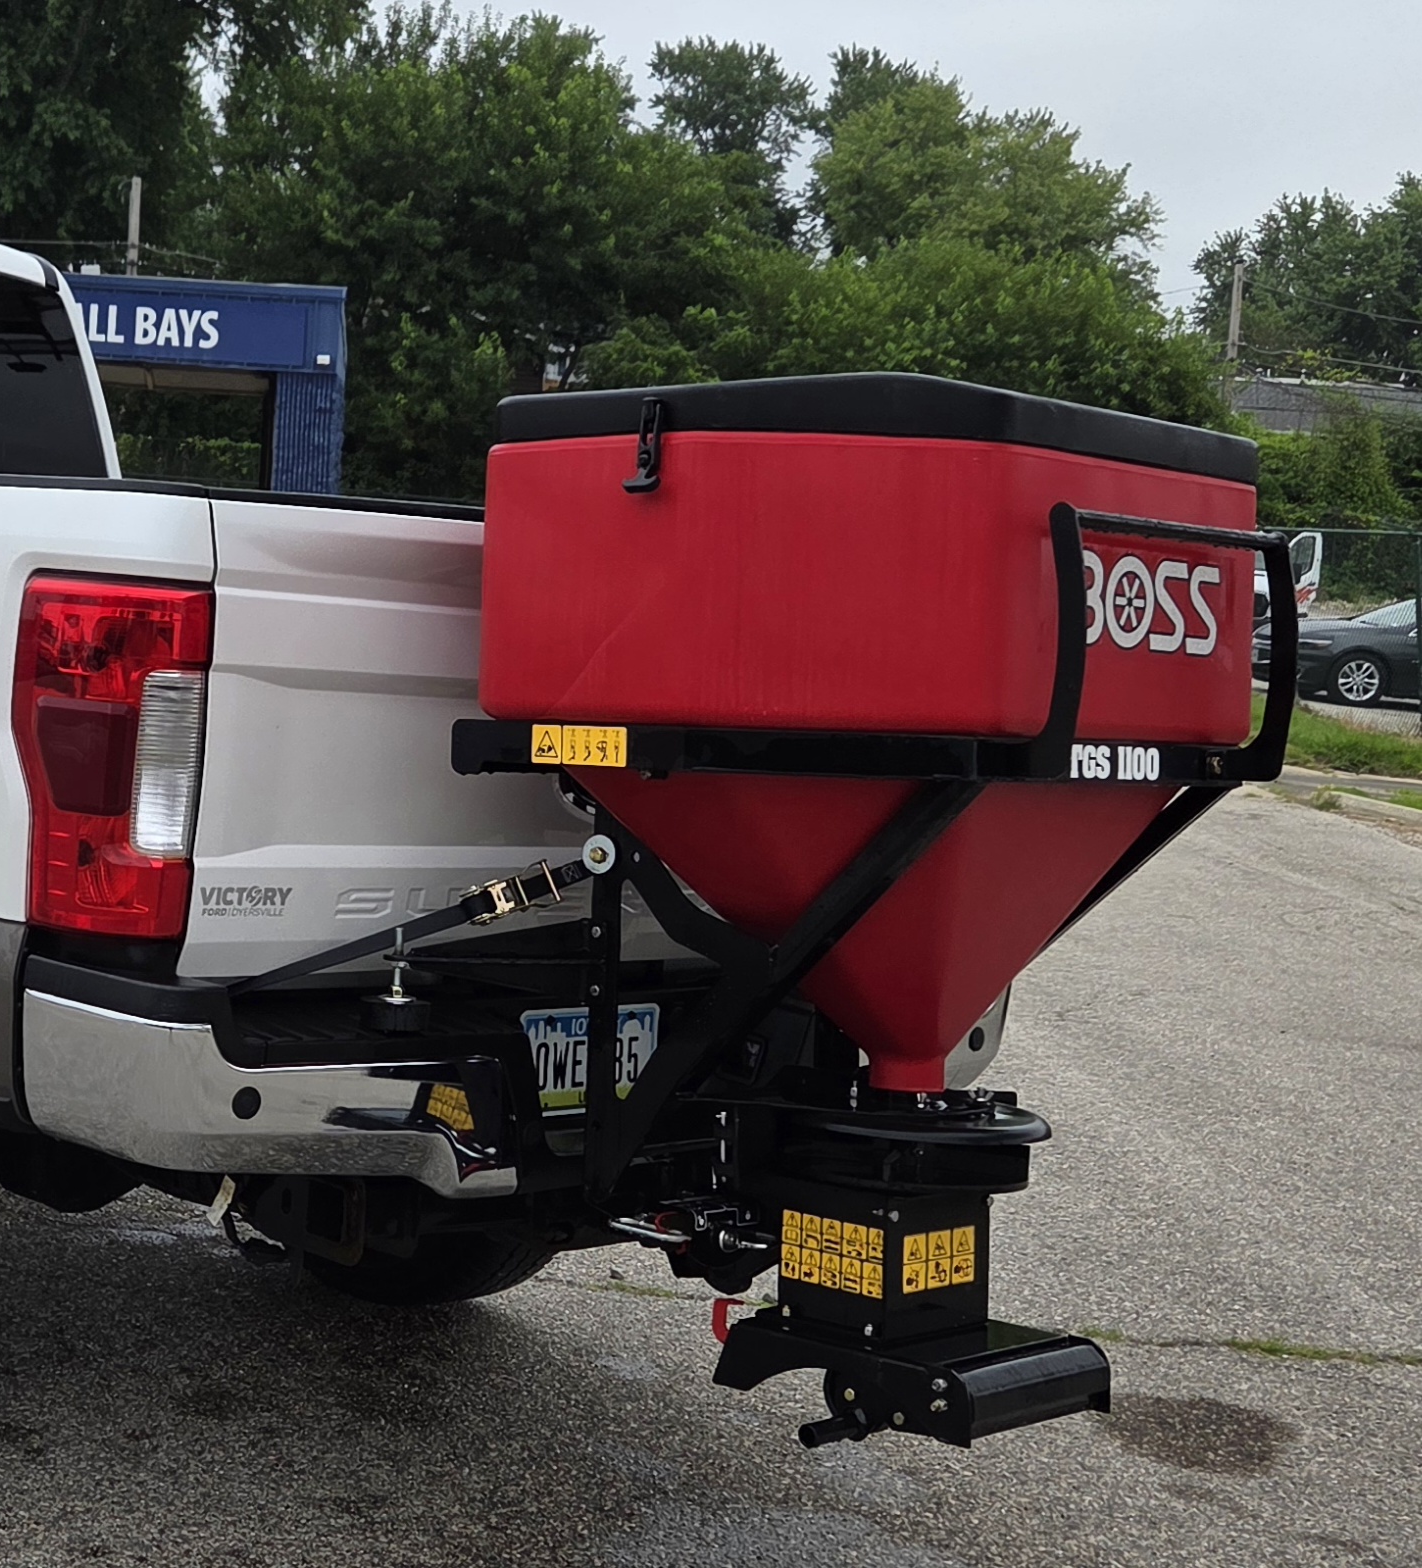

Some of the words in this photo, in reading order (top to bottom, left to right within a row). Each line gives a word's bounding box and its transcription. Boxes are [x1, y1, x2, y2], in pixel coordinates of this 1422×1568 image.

[134, 306, 219, 349] BAYS
[1117, 746, 1160, 781] 1100
[200, 886, 293, 907] VICTORY
[201, 908, 227, 917] FORD
[231, 907, 285, 917] DYERSVILLE
